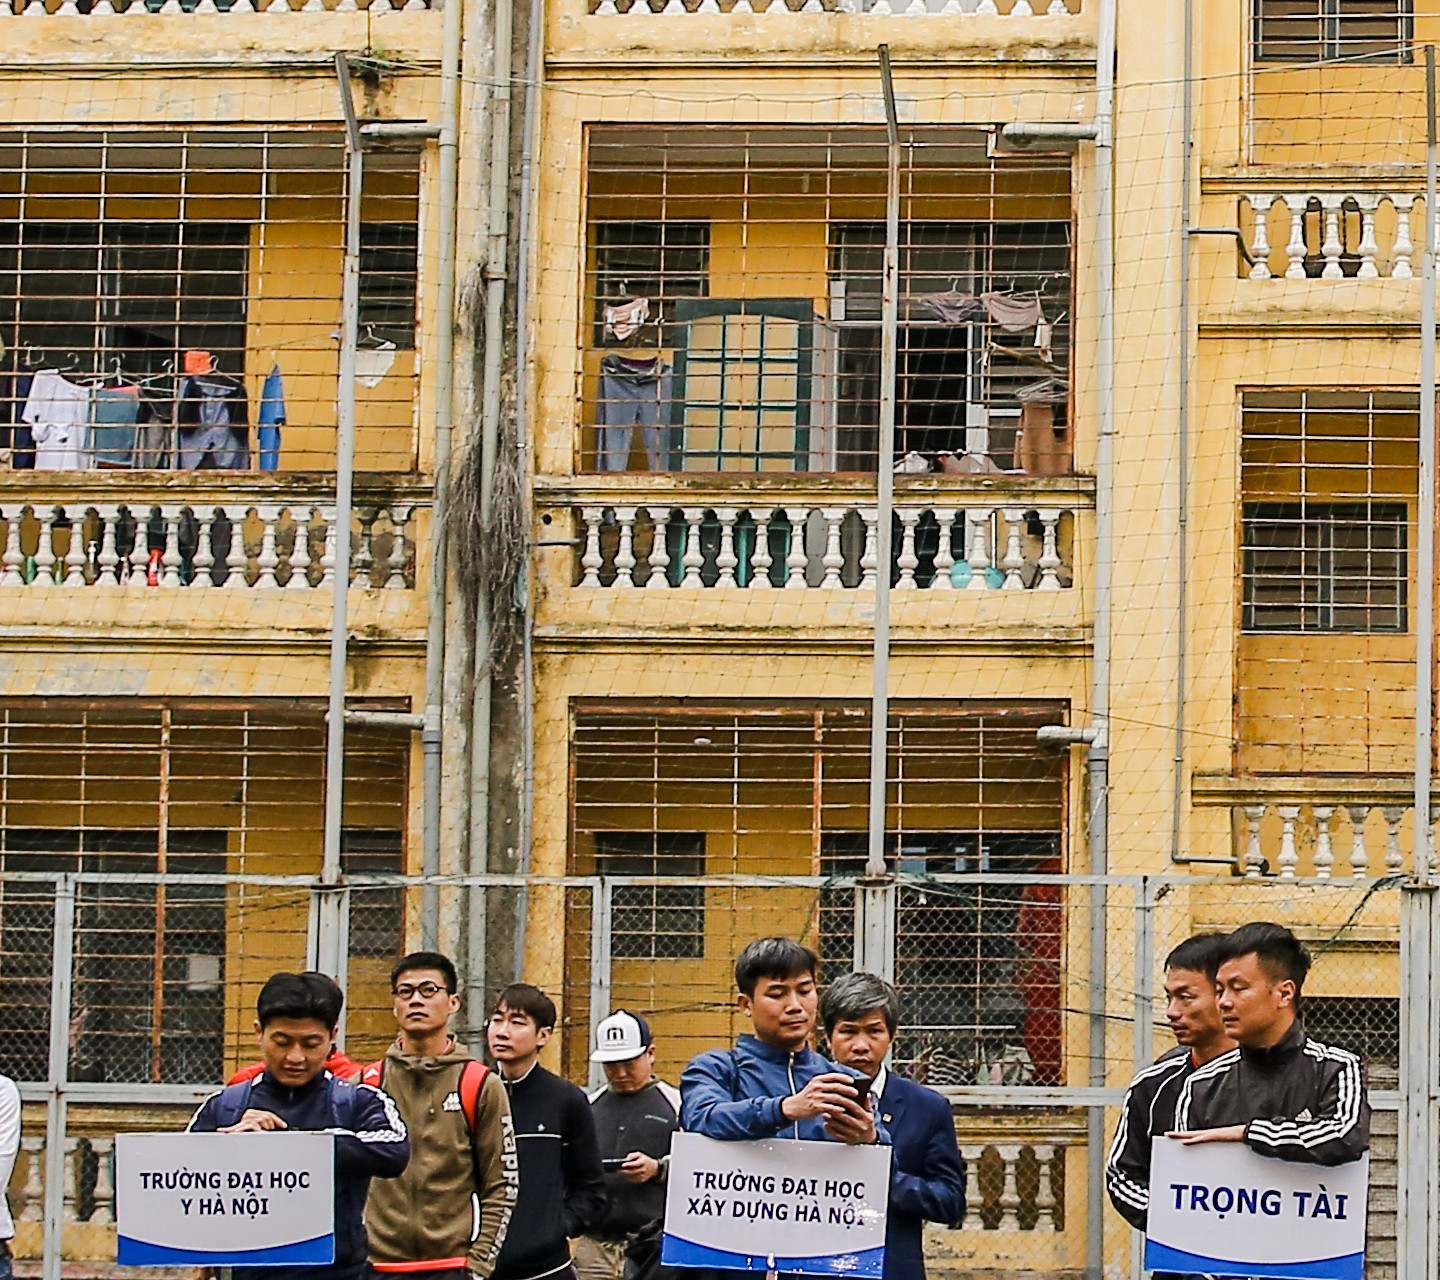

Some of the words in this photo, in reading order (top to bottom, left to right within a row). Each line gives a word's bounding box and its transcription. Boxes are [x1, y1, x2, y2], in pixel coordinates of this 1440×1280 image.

[500, 1115, 519, 1200] Kappa
[140, 1167, 221, 1189] TRƯỜNG
[228, 1172, 263, 1193] ĐẠI
[270, 1172, 310, 1193] HỌC
[693, 1169, 775, 1193] TRƯỜNG
[782, 1178, 818, 1200] ĐẠI
[824, 1181, 865, 1202] HỌC
[181, 1199, 192, 1215] Y
[199, 1193, 225, 1215] HÀ
[232, 1192, 269, 1219] NỘI
[687, 1193, 726, 1216] XÂY
[733, 1200, 788, 1222] DỰNG
[795, 1201, 821, 1223] HÀ
[1170, 1184, 1281, 1219] TRỌNG
[1293, 1184, 1349, 1220] TÀI
